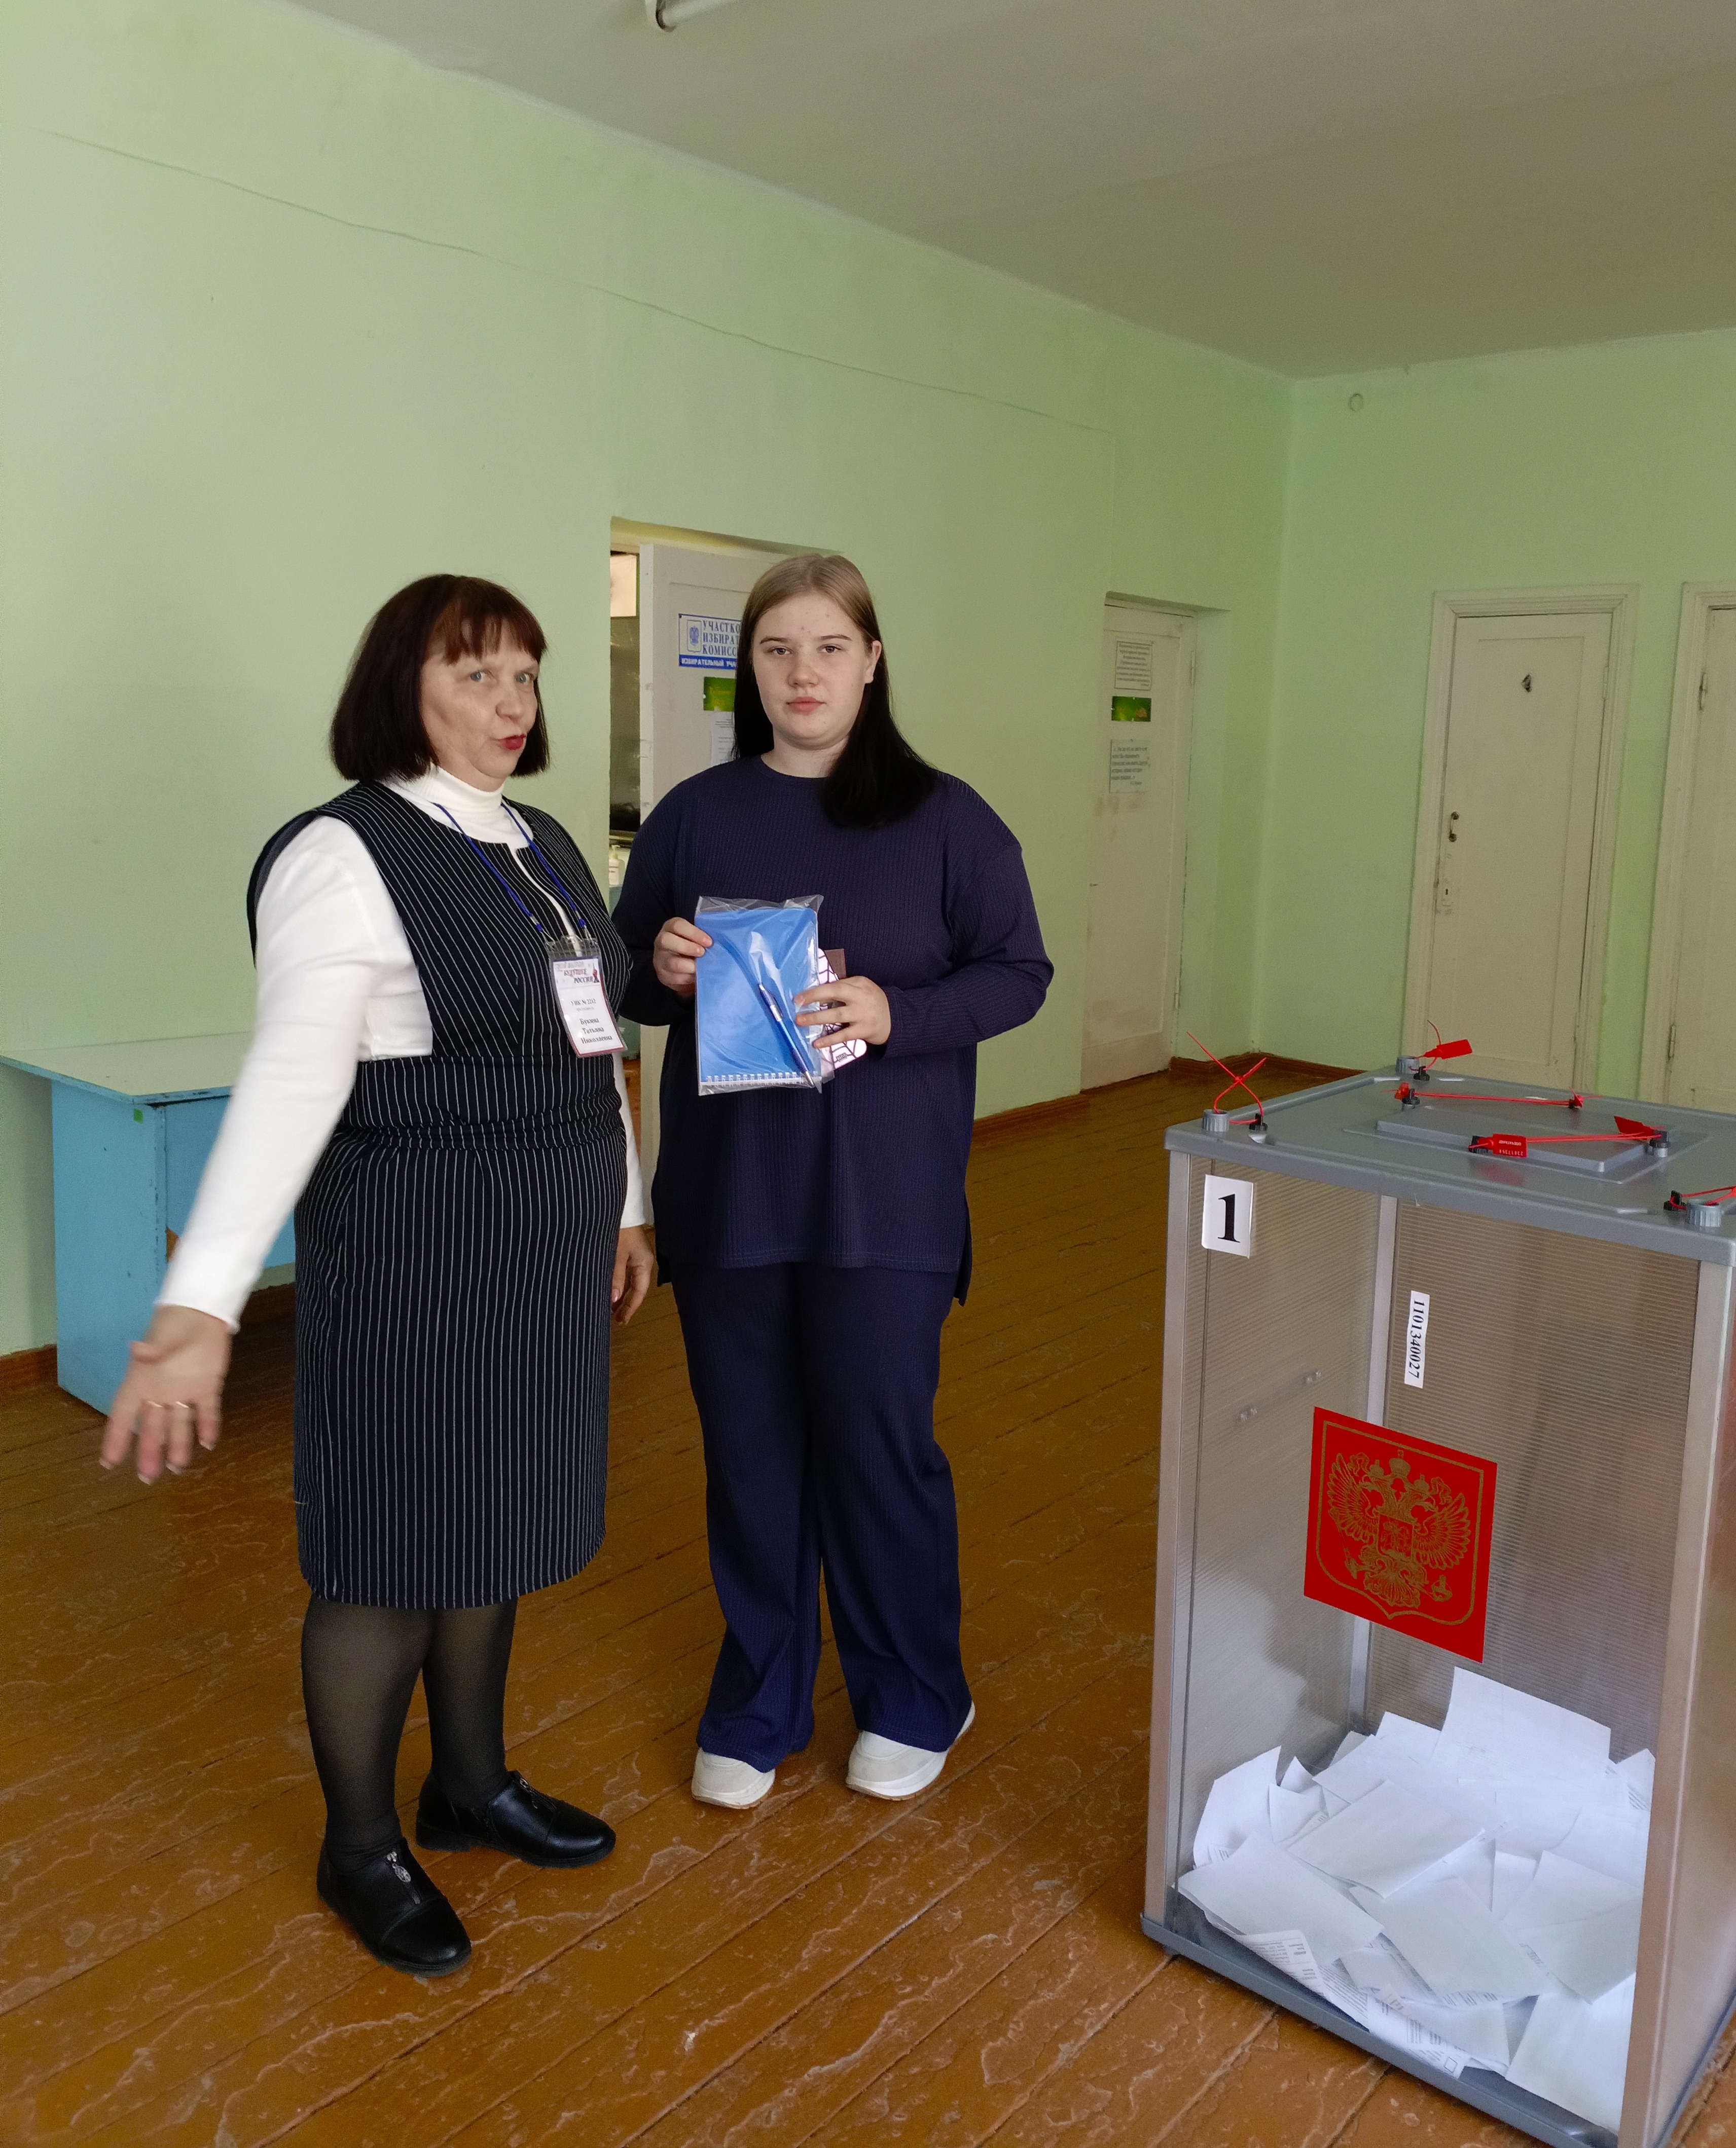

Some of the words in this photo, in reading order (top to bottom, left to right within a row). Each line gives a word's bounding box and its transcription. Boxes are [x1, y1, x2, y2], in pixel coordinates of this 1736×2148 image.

[581, 1036, 613, 1044] Николаевна
[1218, 1193, 1241, 1243] 1
[1408, 1300, 1425, 1379] 1101340027
